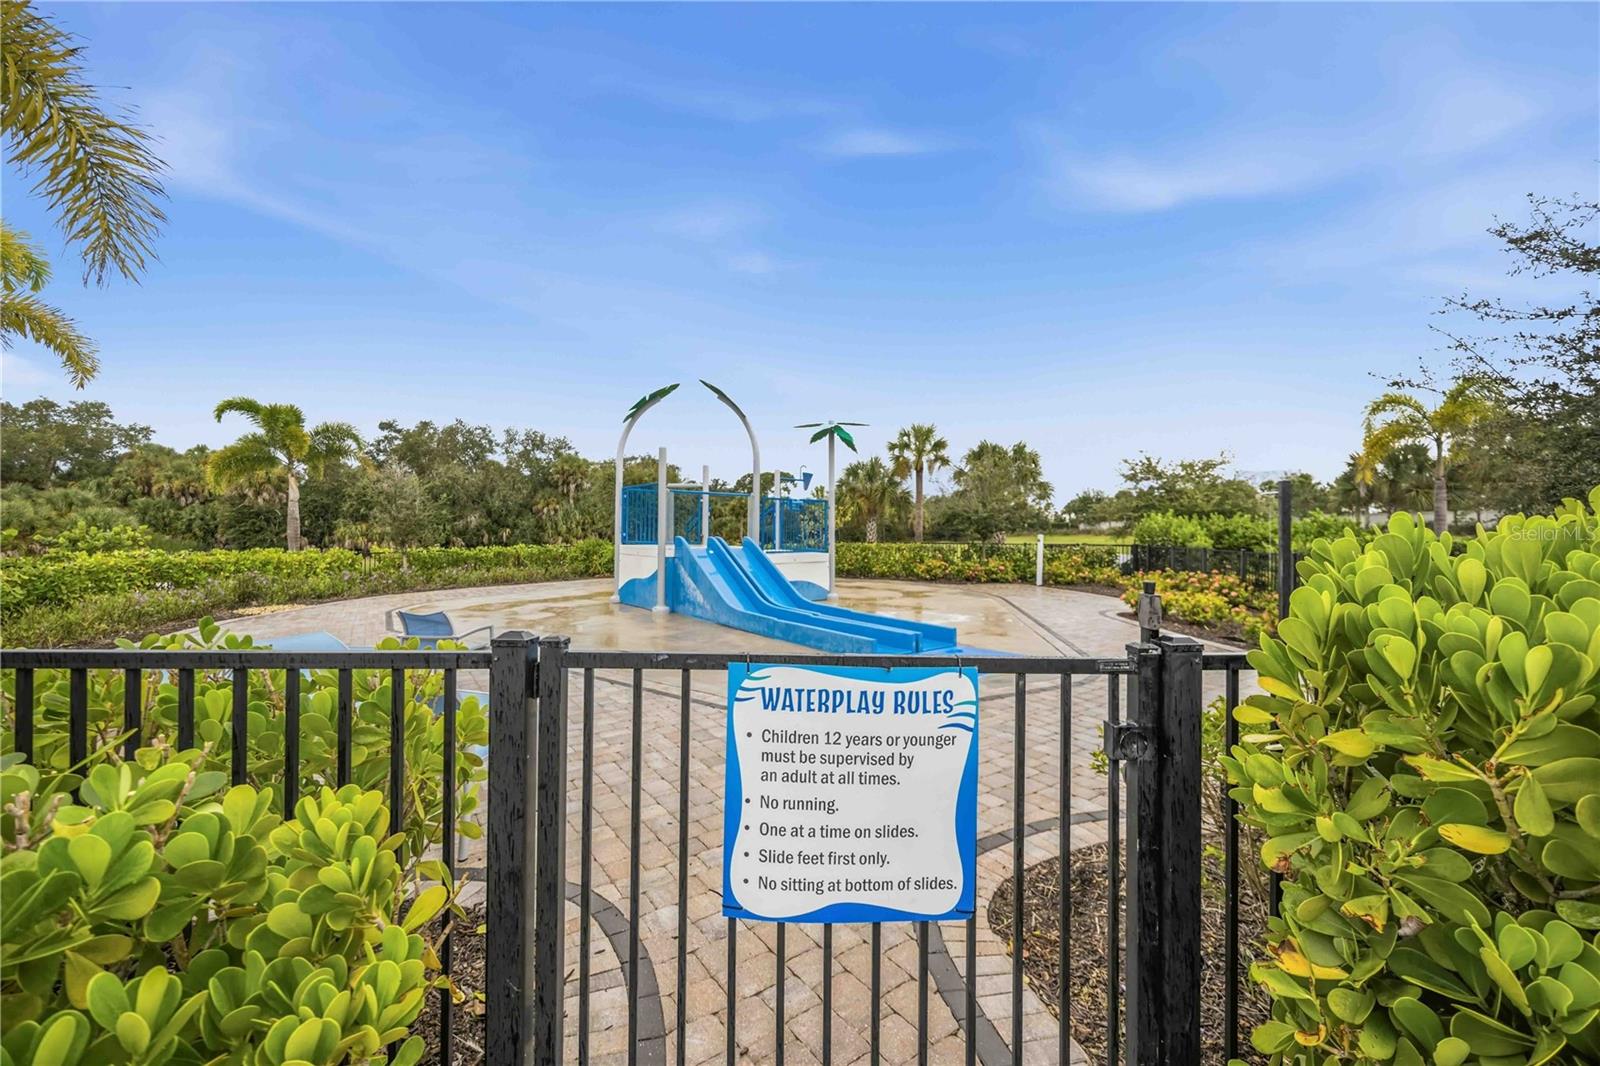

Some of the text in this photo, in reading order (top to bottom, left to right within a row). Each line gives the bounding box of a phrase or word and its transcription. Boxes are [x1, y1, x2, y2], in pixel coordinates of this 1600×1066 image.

[761, 687, 954, 714] WATERPLAY RULES
[761, 729, 957, 749] Children 12 years or younger
[761, 751, 914, 768] must be supervised by
[761, 770, 900, 785] an adult at all times.
[760, 795, 839, 814] No running.
[759, 823, 918, 838] One at a time on slides.
[759, 849, 890, 867] Slide feet first only.
[758, 877, 957, 894] No sitting at bottom of slides.
